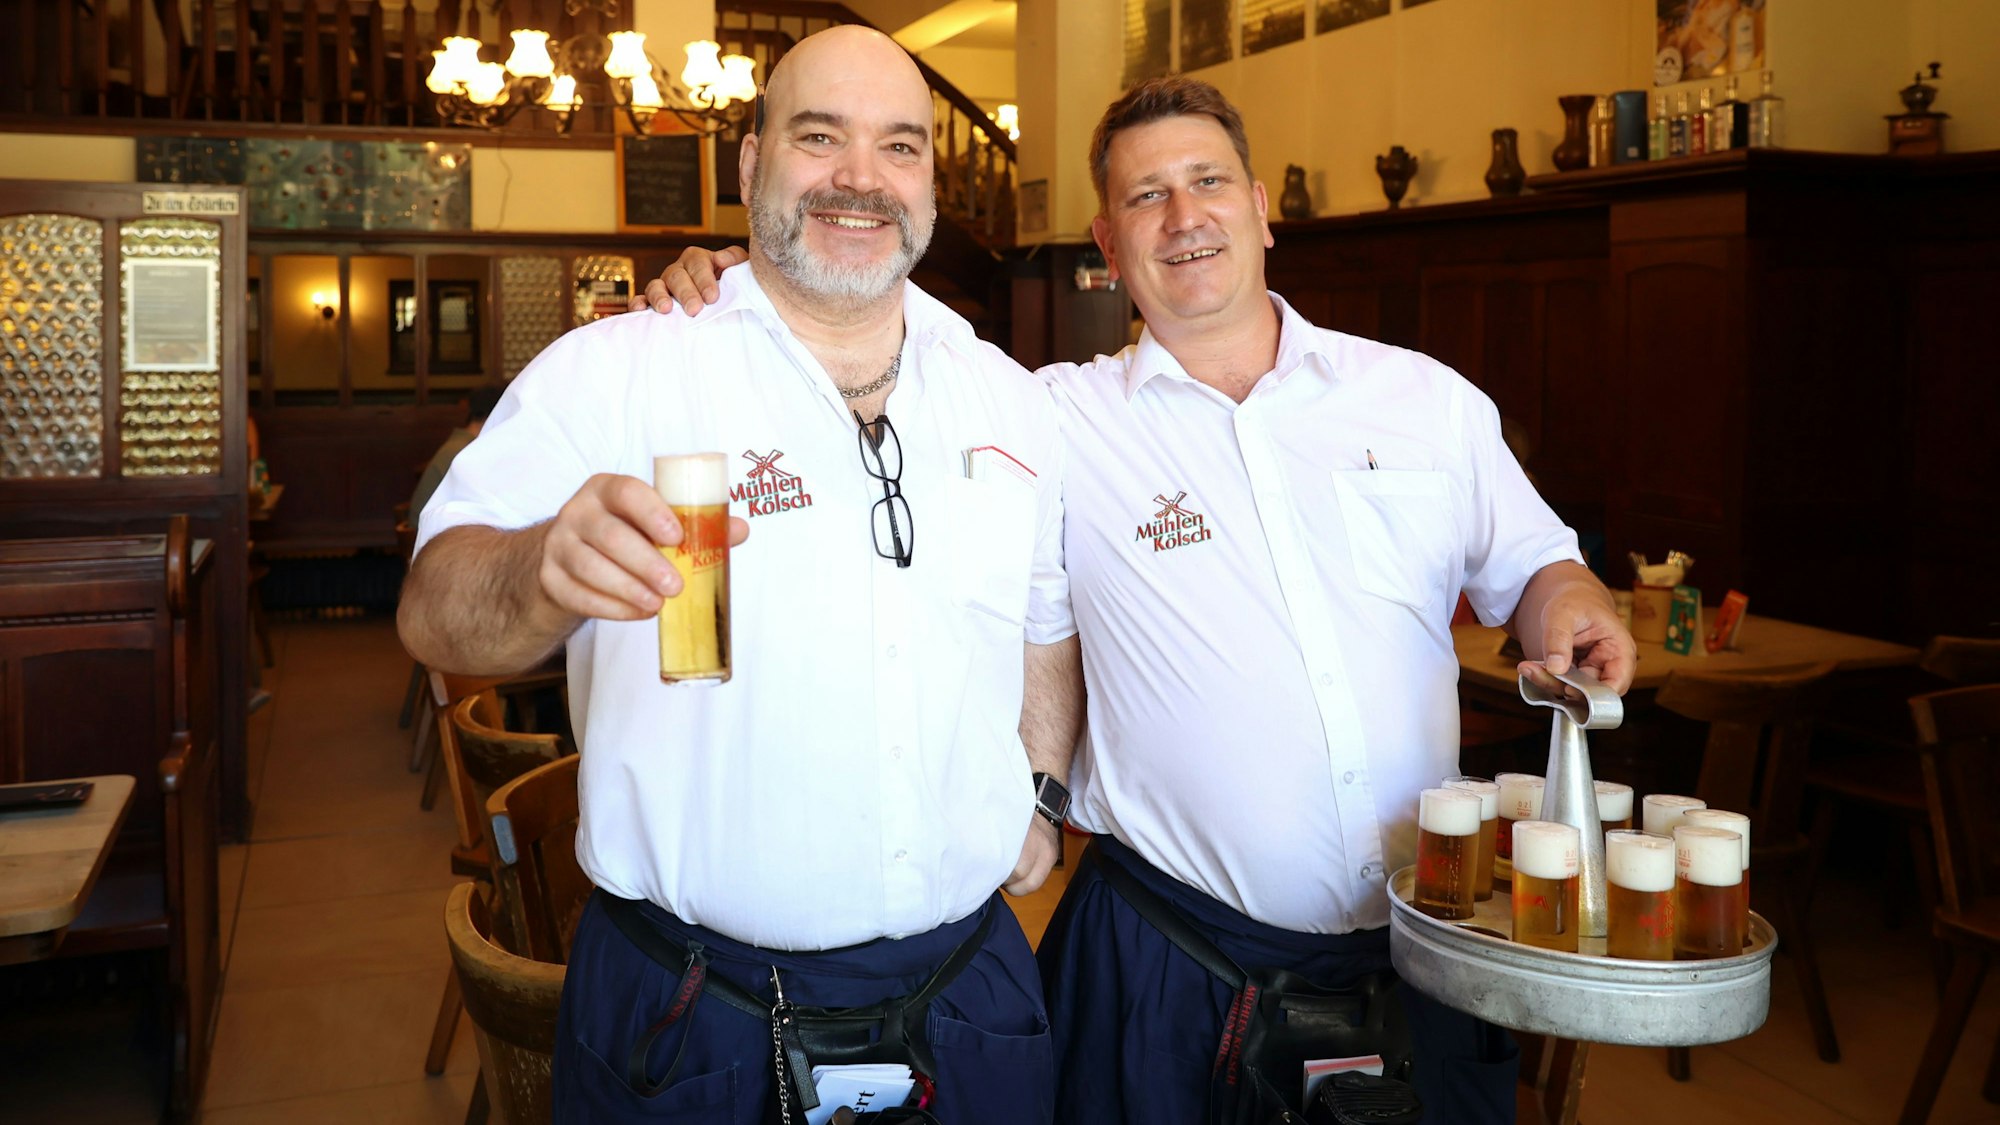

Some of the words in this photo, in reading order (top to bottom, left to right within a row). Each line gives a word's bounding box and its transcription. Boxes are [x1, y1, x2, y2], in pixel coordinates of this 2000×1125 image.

[729, 474, 803, 502] Mühlen
[748, 490, 813, 518] Kölsch
[1135, 513, 1204, 541] Mühlen
[1154, 526, 1212, 552] Kölsch
